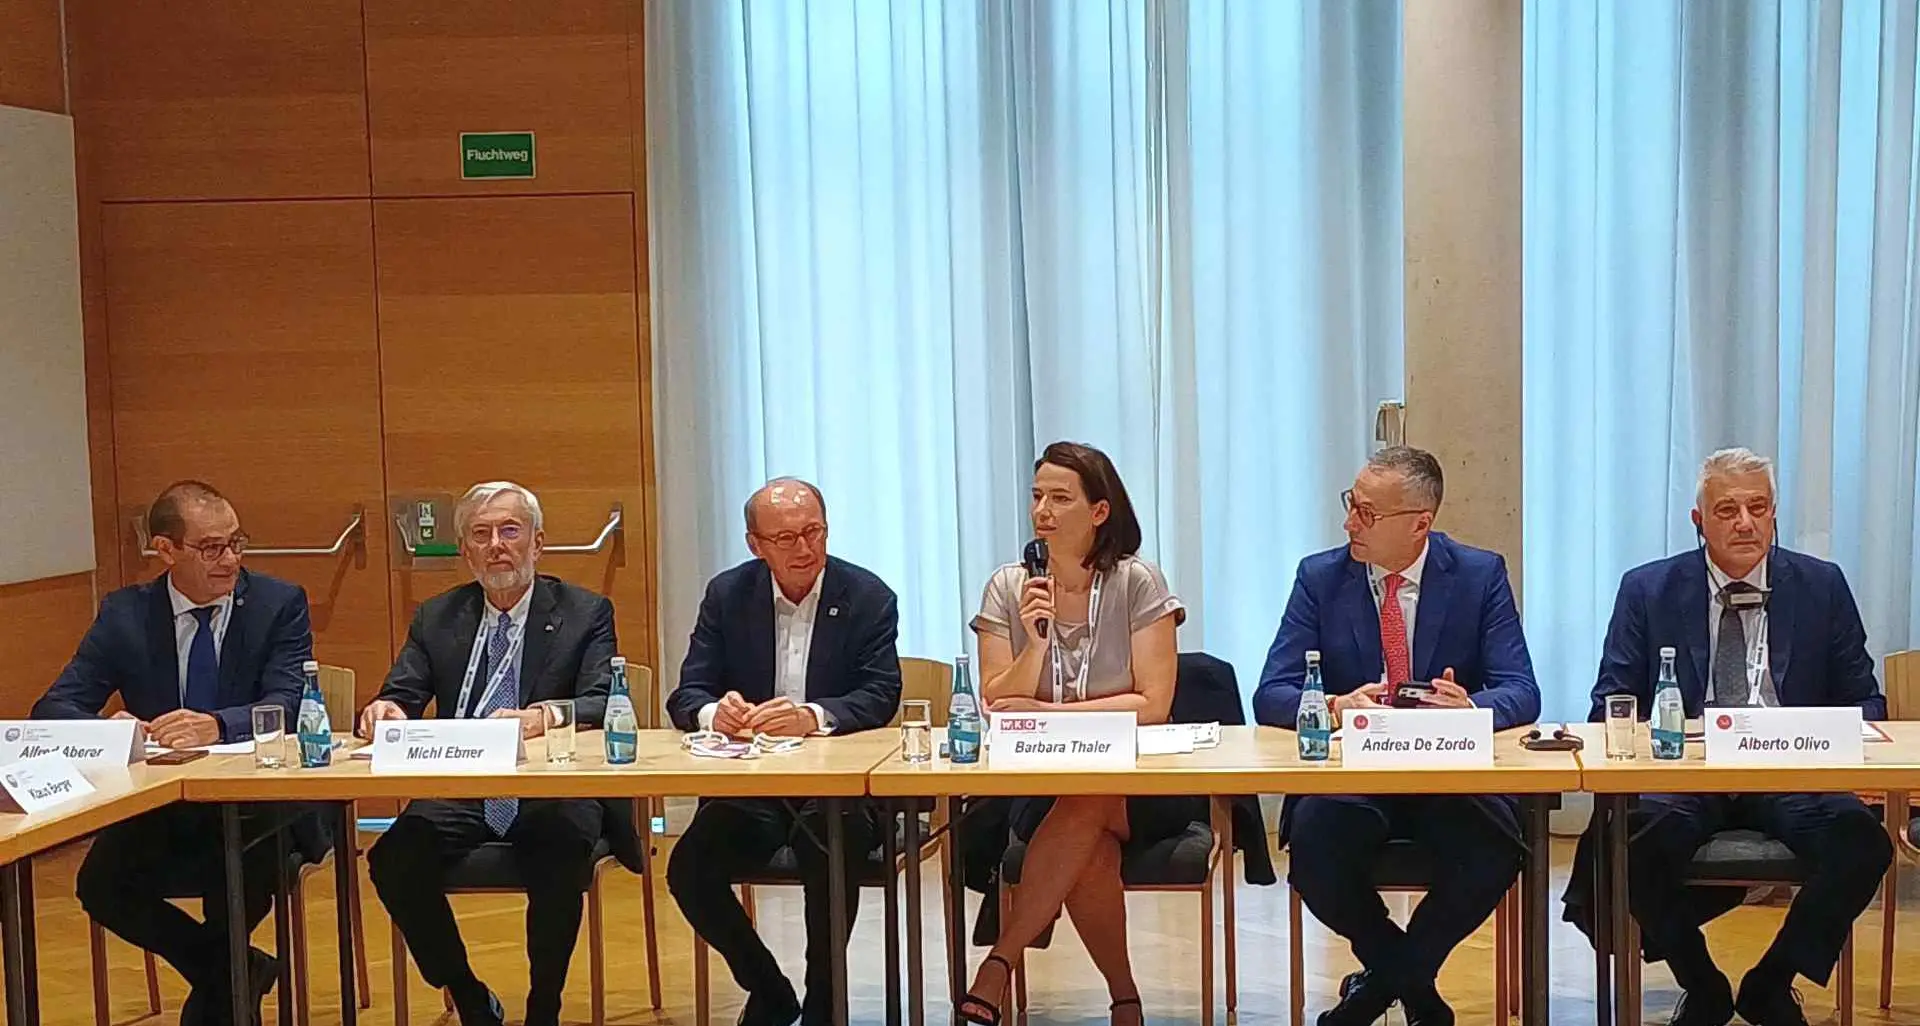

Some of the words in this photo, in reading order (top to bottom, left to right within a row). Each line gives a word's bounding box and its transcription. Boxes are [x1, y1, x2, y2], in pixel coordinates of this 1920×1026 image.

[467, 148, 528, 162] Fluchtweg
[1002, 719, 1036, 730] WKO
[1015, 740, 1066, 754] Barbara
[1071, 740, 1112, 754] Thaler
[1362, 737, 1410, 751] Andrea
[1414, 737, 1432, 751] De
[1436, 737, 1476, 751] Zordo
[1738, 737, 1789, 751] Alberto
[1794, 737, 1830, 751] Olivo
[62, 745, 104, 758] Aberer
[407, 746, 443, 760] Michl
[445, 746, 485, 759] Ebner
